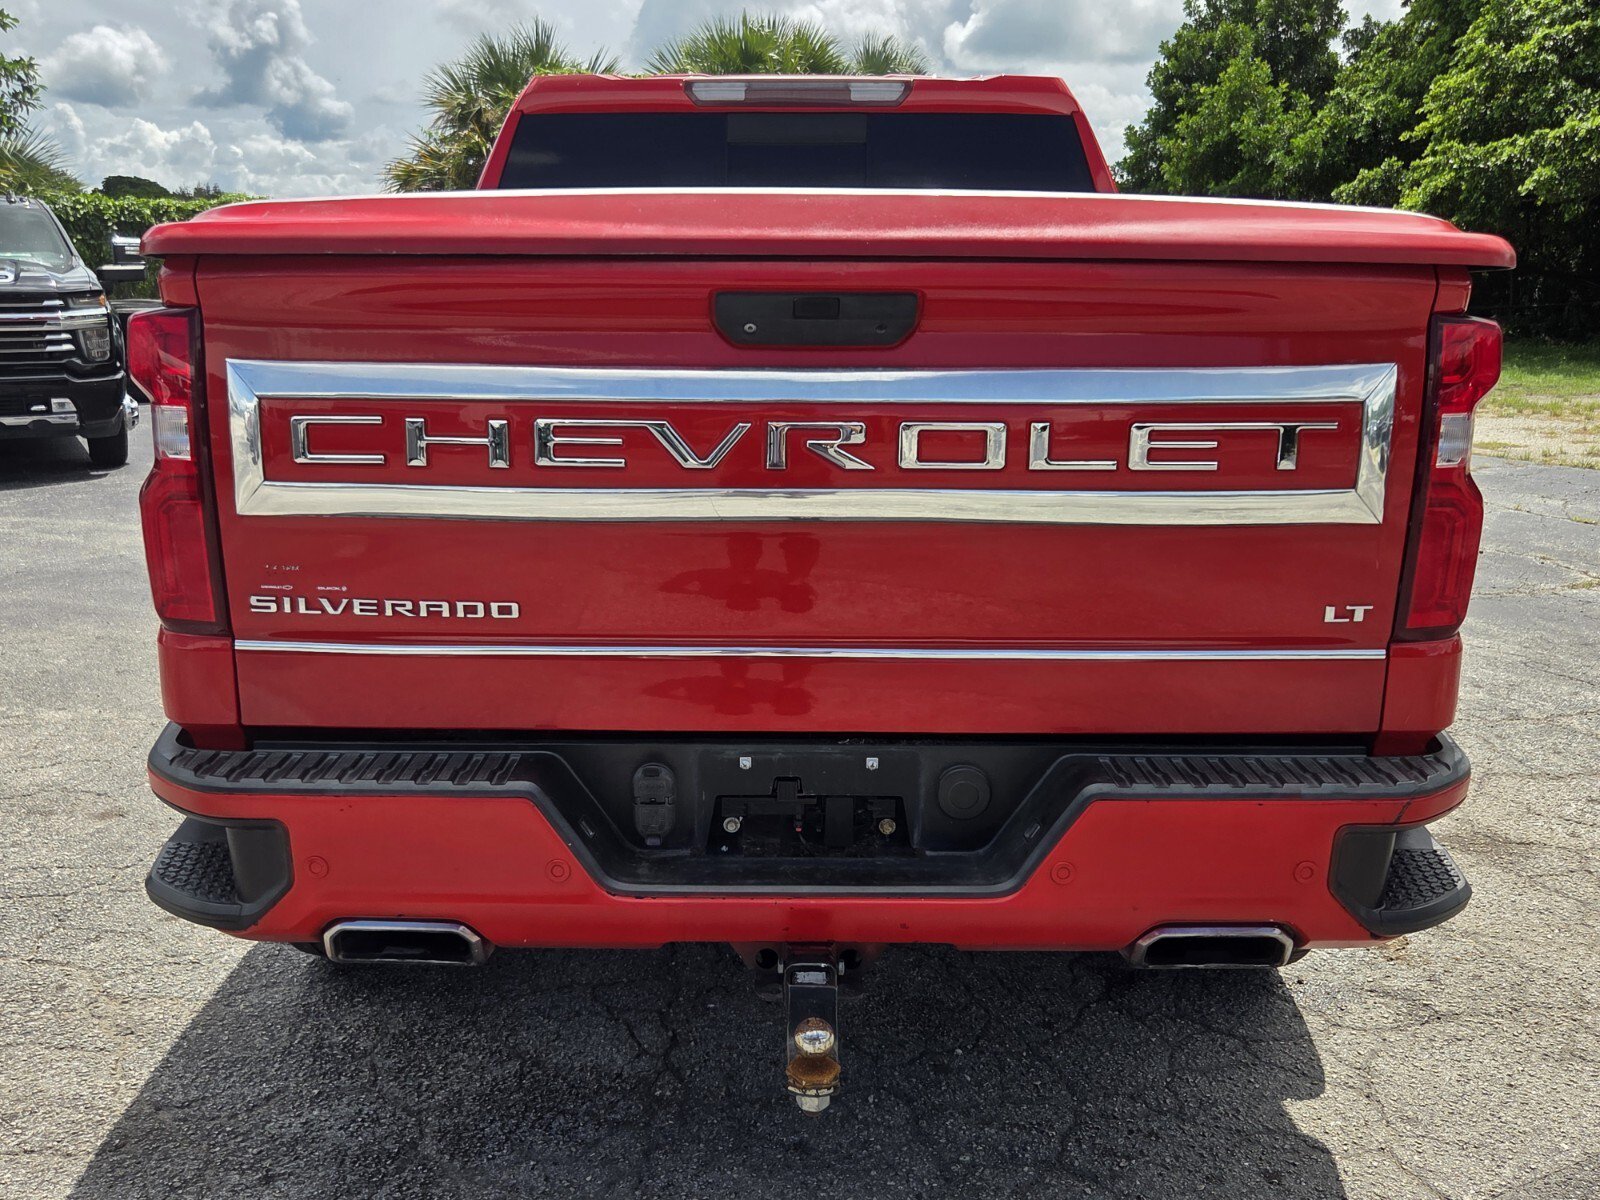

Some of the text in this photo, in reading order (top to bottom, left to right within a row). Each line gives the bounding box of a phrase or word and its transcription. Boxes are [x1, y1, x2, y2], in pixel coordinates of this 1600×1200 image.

[290, 415, 1338, 472] CHEVROLET
[249, 595, 520, 619] SILVERADO
[1324, 605, 1374, 623] LT
